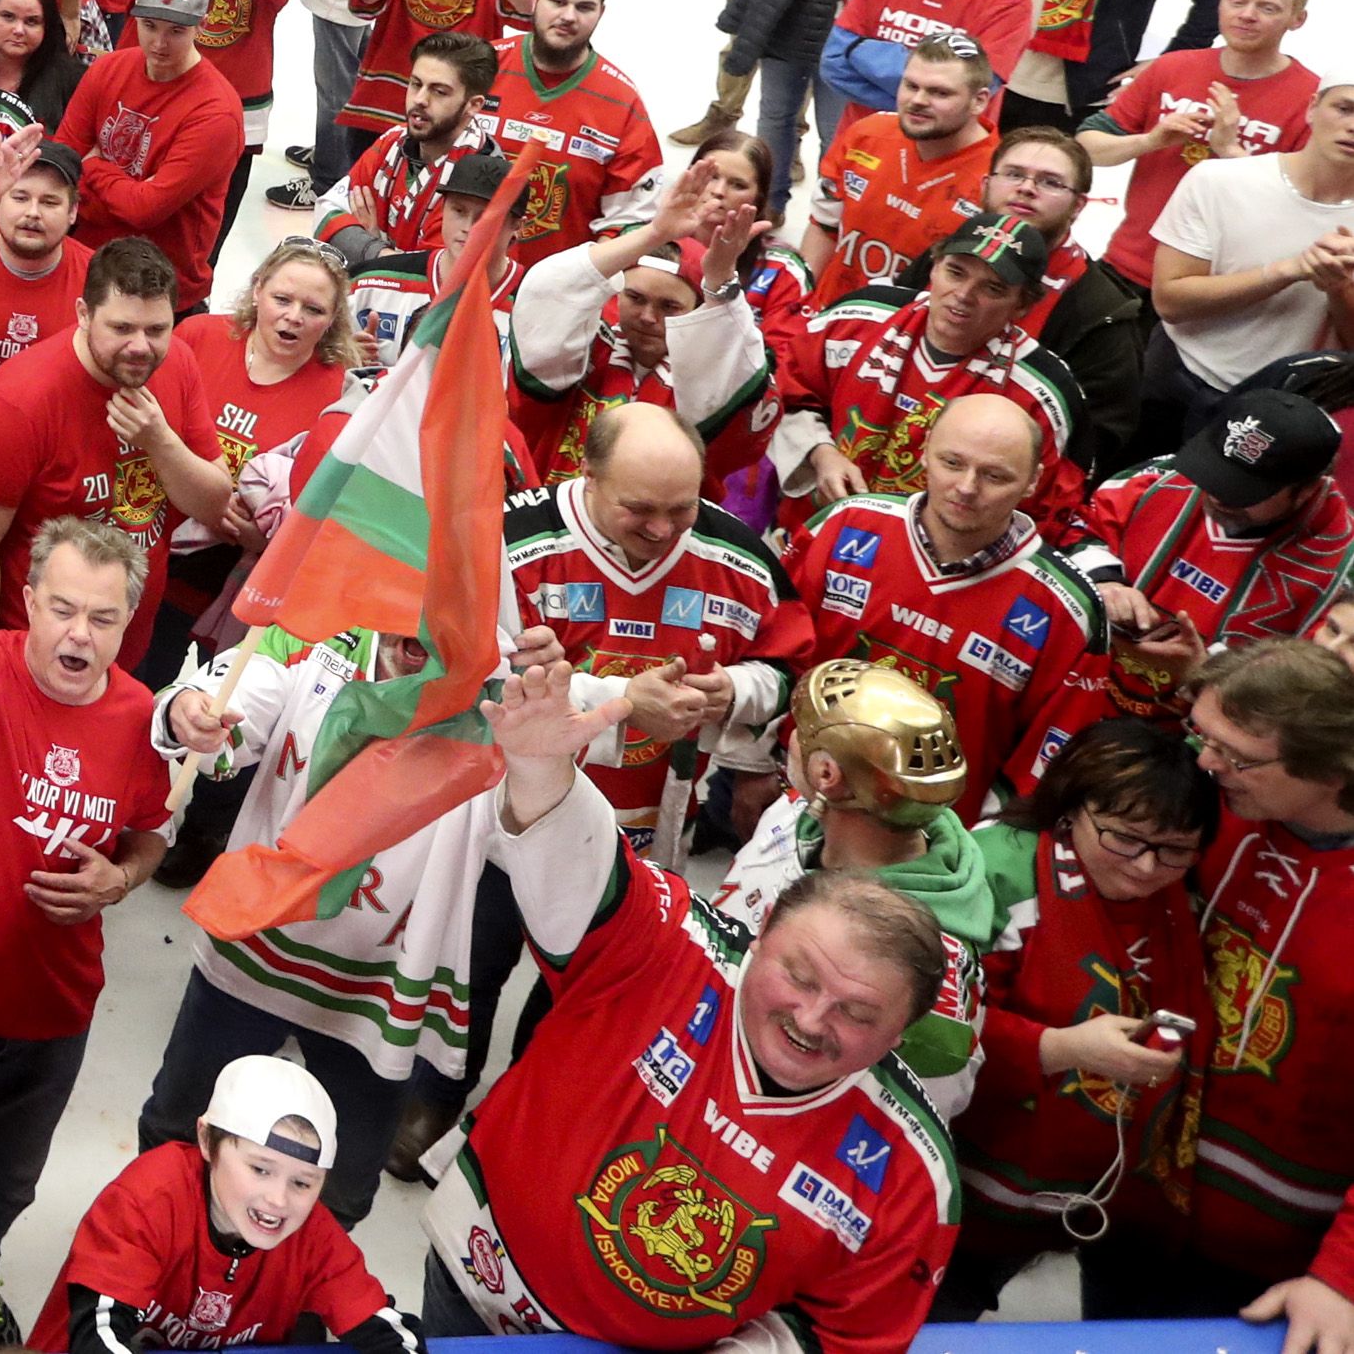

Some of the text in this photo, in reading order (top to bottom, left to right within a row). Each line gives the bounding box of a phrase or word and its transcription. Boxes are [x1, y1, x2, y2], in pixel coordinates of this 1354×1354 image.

[880, 7, 970, 39] MORA
[886, 193, 921, 219] WIBE
[972, 225, 1024, 256] MORA
[215, 403, 261, 440] SHL
[83, 474, 110, 504] 20
[1171, 558, 1227, 603] WIBE
[615, 621, 653, 637] WIBE
[890, 604, 955, 645] WIBE
[26, 773, 117, 823] KÖR VI MOT
[937, 931, 961, 1013] MAXI
[702, 1096, 777, 1175] WIBE
[877, 1087, 939, 1164] FM Mattsson
[590, 1158, 639, 1207] MORA
[709, 1244, 757, 1303] KLUBB
[158, 1311, 191, 1347] KÖR
